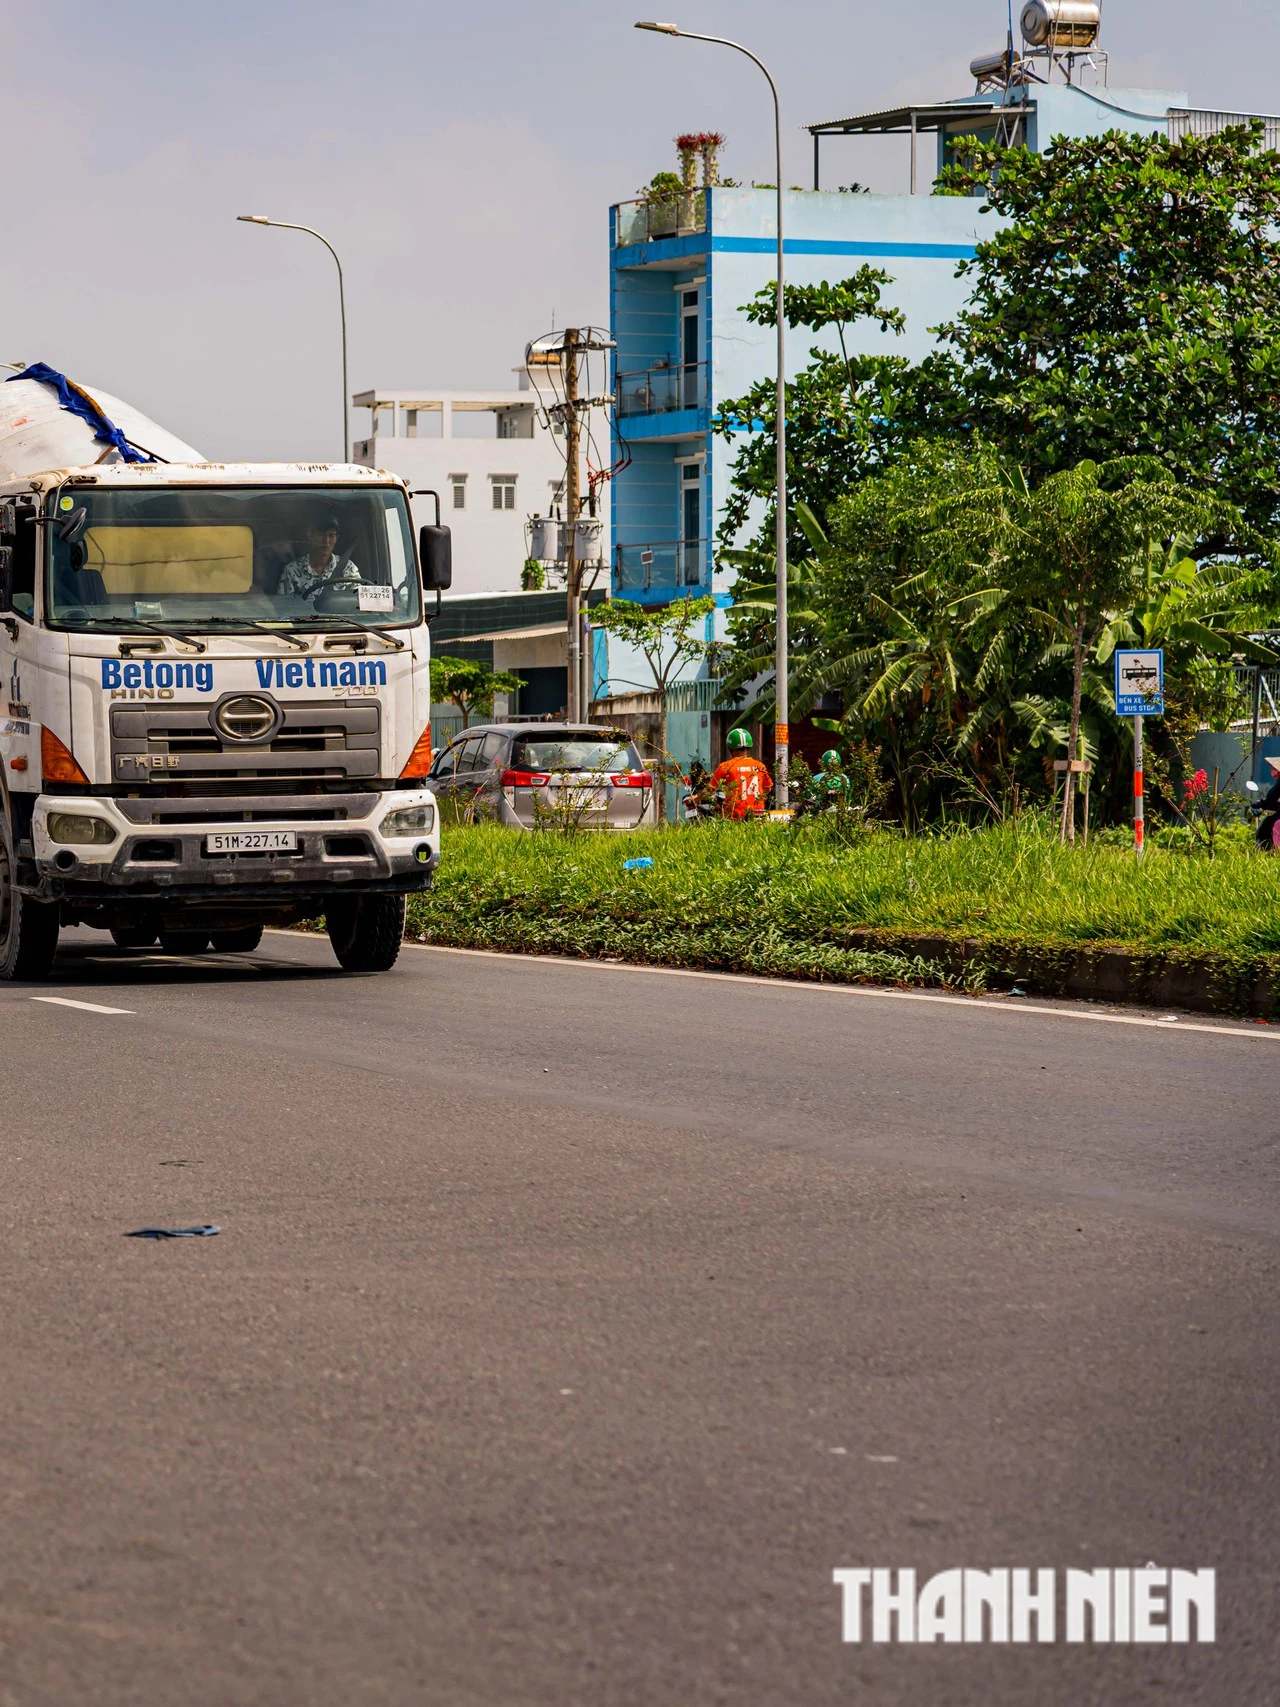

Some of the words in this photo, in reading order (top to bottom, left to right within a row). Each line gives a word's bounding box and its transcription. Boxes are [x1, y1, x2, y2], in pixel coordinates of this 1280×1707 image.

[101, 659, 214, 692] Betong
[255, 657, 387, 688] Vietnam
[111, 688, 175, 699] HINO
[119, 756, 180, 768] 广汽日野
[739, 775, 761, 801] 14
[215, 834, 289, 849] 51M-227.14
